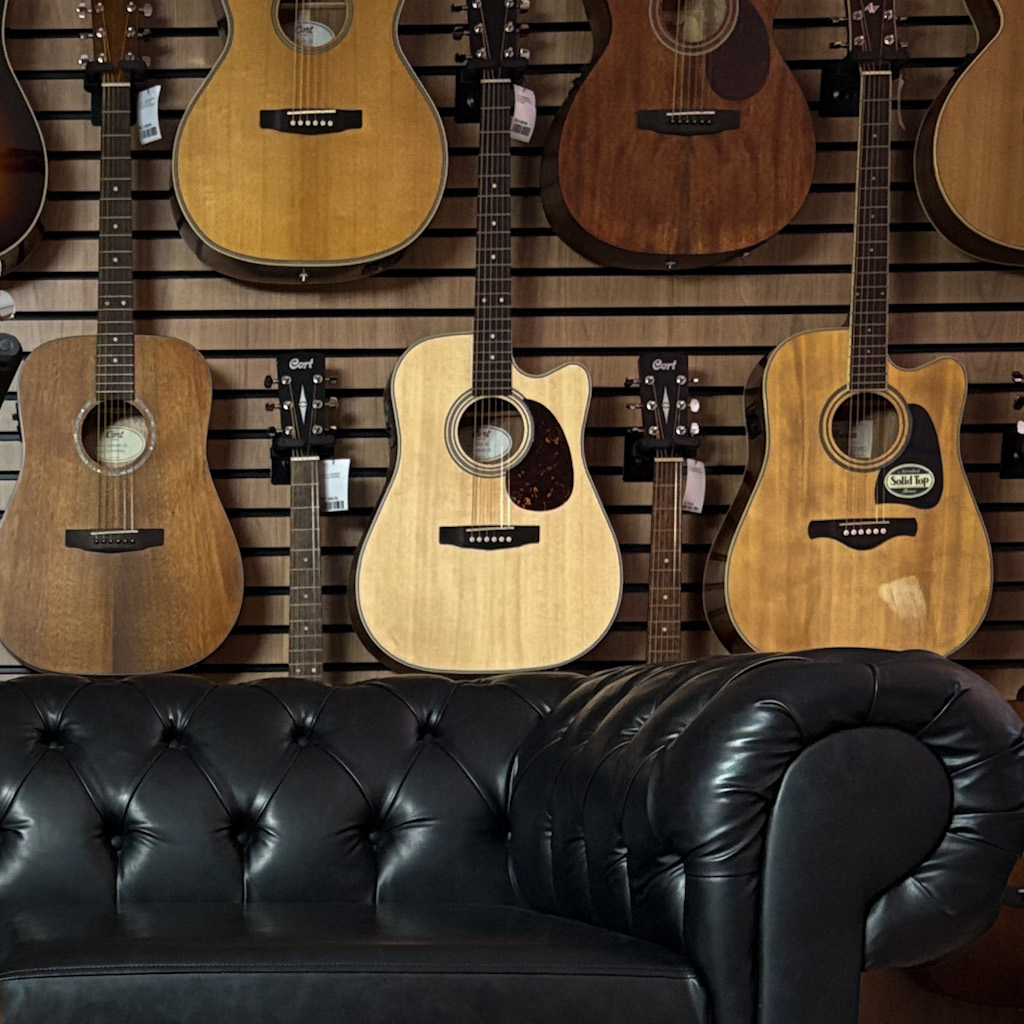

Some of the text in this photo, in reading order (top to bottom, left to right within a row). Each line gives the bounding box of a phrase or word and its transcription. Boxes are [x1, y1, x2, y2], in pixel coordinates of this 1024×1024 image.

[289, 357, 314, 370] Cort
[652, 358, 677, 371] Cort
[106, 430, 125, 439] Cort
[890, 475, 930, 487] Solid Top
